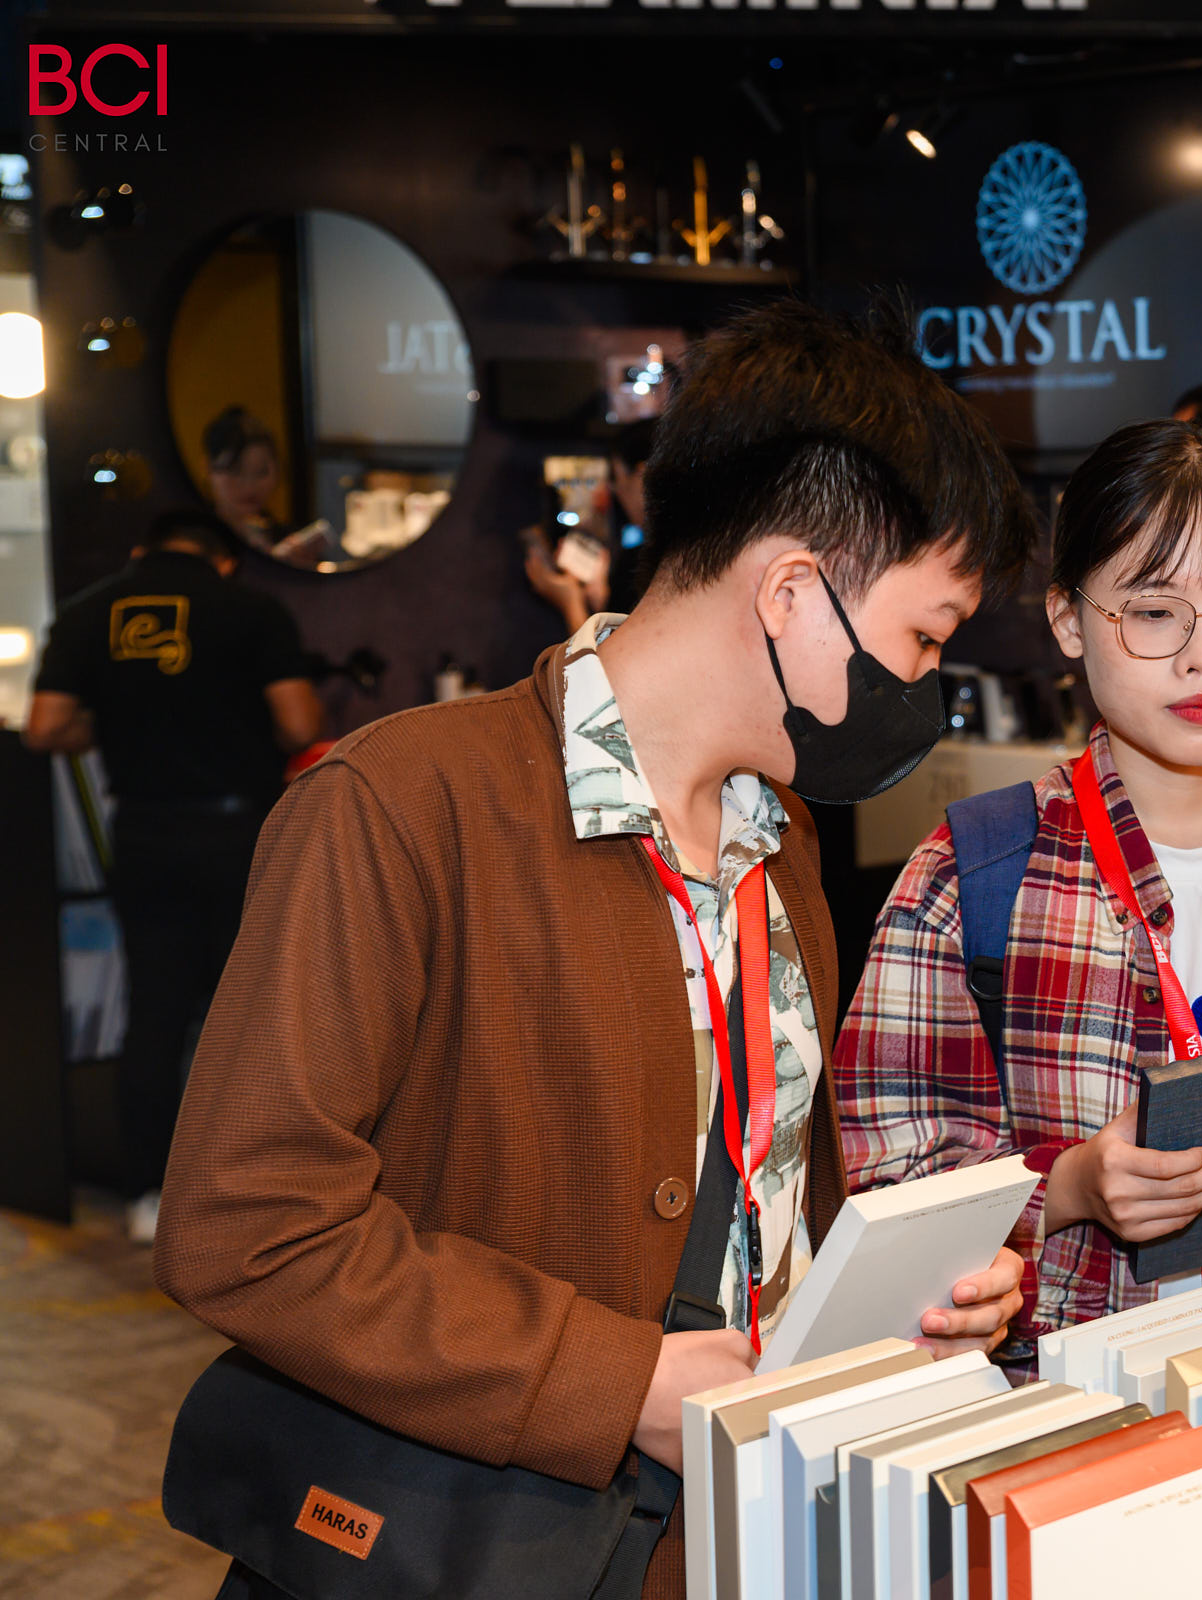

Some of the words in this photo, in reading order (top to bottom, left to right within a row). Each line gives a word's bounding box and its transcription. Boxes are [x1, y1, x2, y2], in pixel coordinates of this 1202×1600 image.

[914, 297, 1168, 370] CRYSTAL
[1186, 1033, 1201, 1058] SIA
[311, 1503, 369, 1540] HARAS
